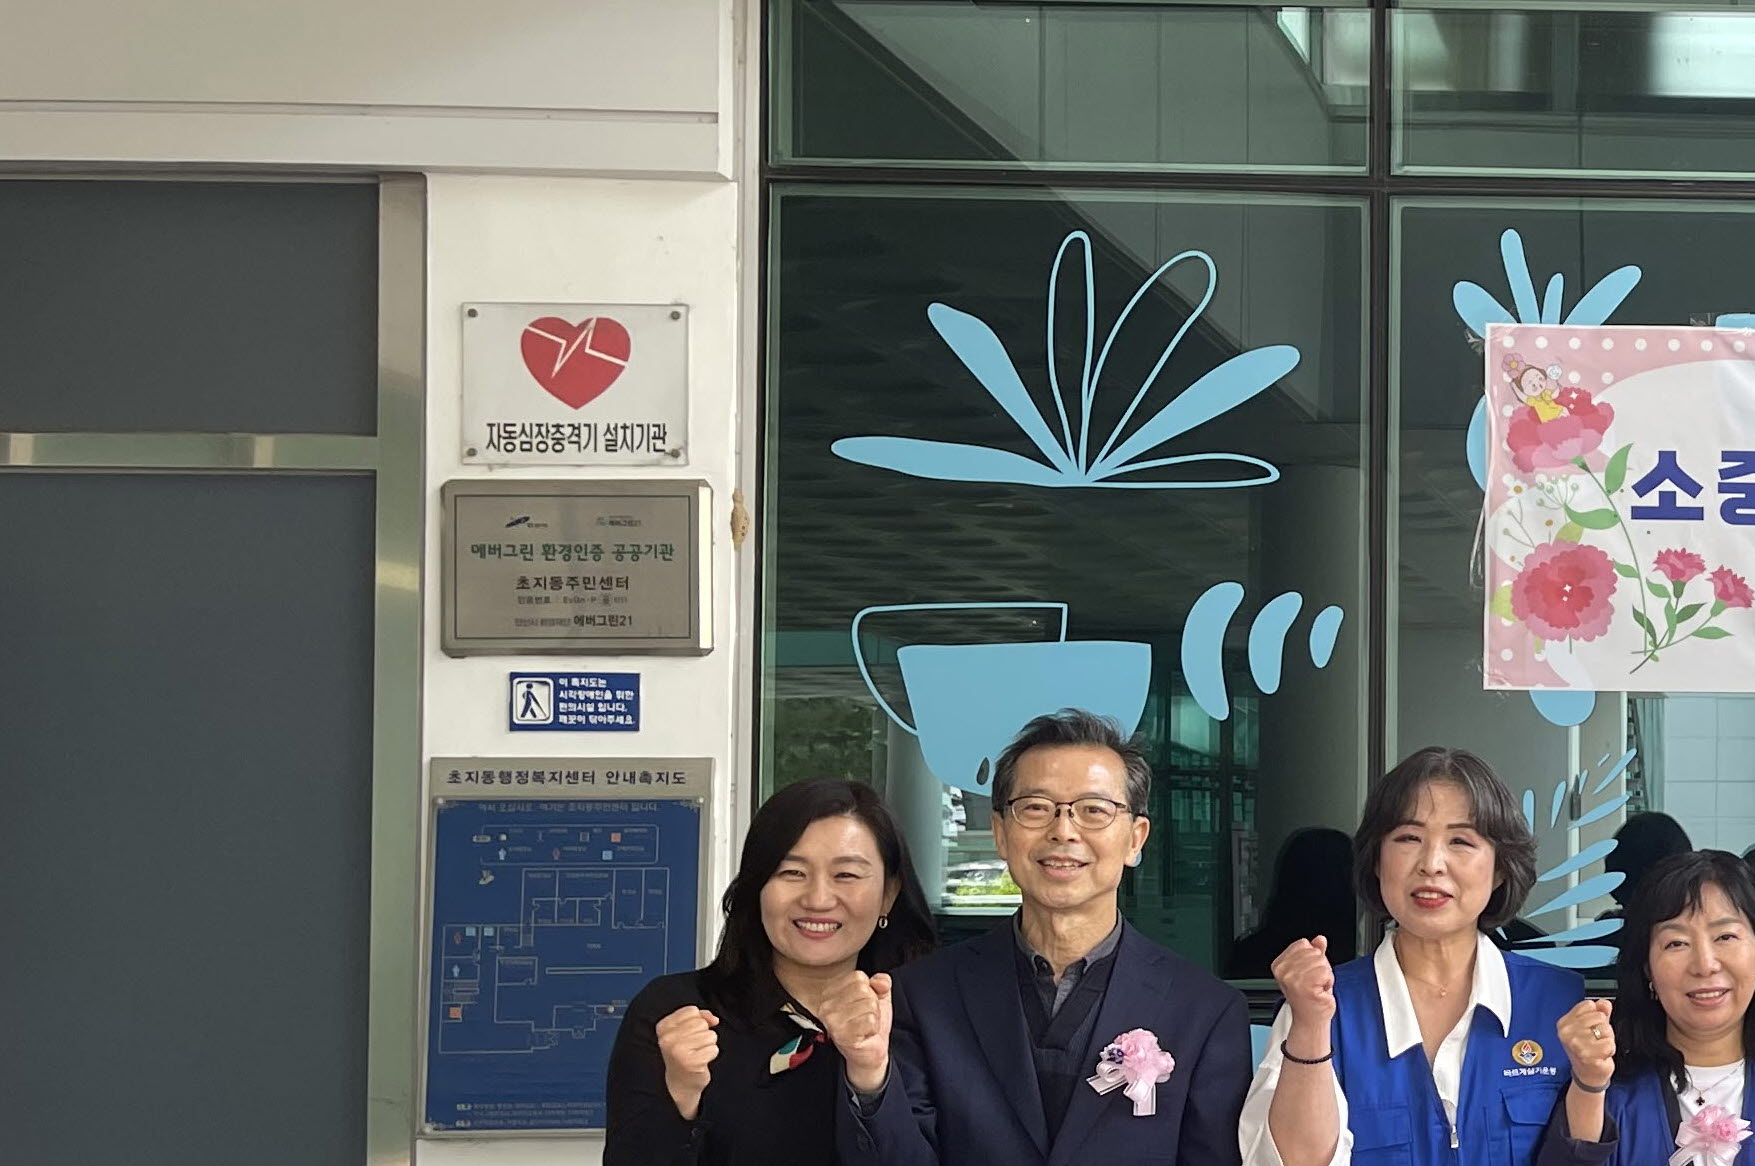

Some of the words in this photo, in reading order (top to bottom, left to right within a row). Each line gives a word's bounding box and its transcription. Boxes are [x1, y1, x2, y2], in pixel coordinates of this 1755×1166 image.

[485, 421, 599, 455] 자동심장충격기
[602, 421, 668, 455] 설치기관
[470, 542, 535, 563] 에버그린
[540, 542, 606, 564] 환경인증
[610, 542, 676, 564] 공공기관
[515, 574, 630, 592] 초지동주민센터
[573, 614, 633, 628] 에버그린21
[558, 677, 569, 688] 이
[559, 689, 613, 701] 시각장애인을
[615, 689, 635, 701] 위한
[558, 702, 595, 712] 편의시설
[447, 769, 597, 786] 초지동행정복지센터
[604, 769, 687, 786] 안내촉지도
